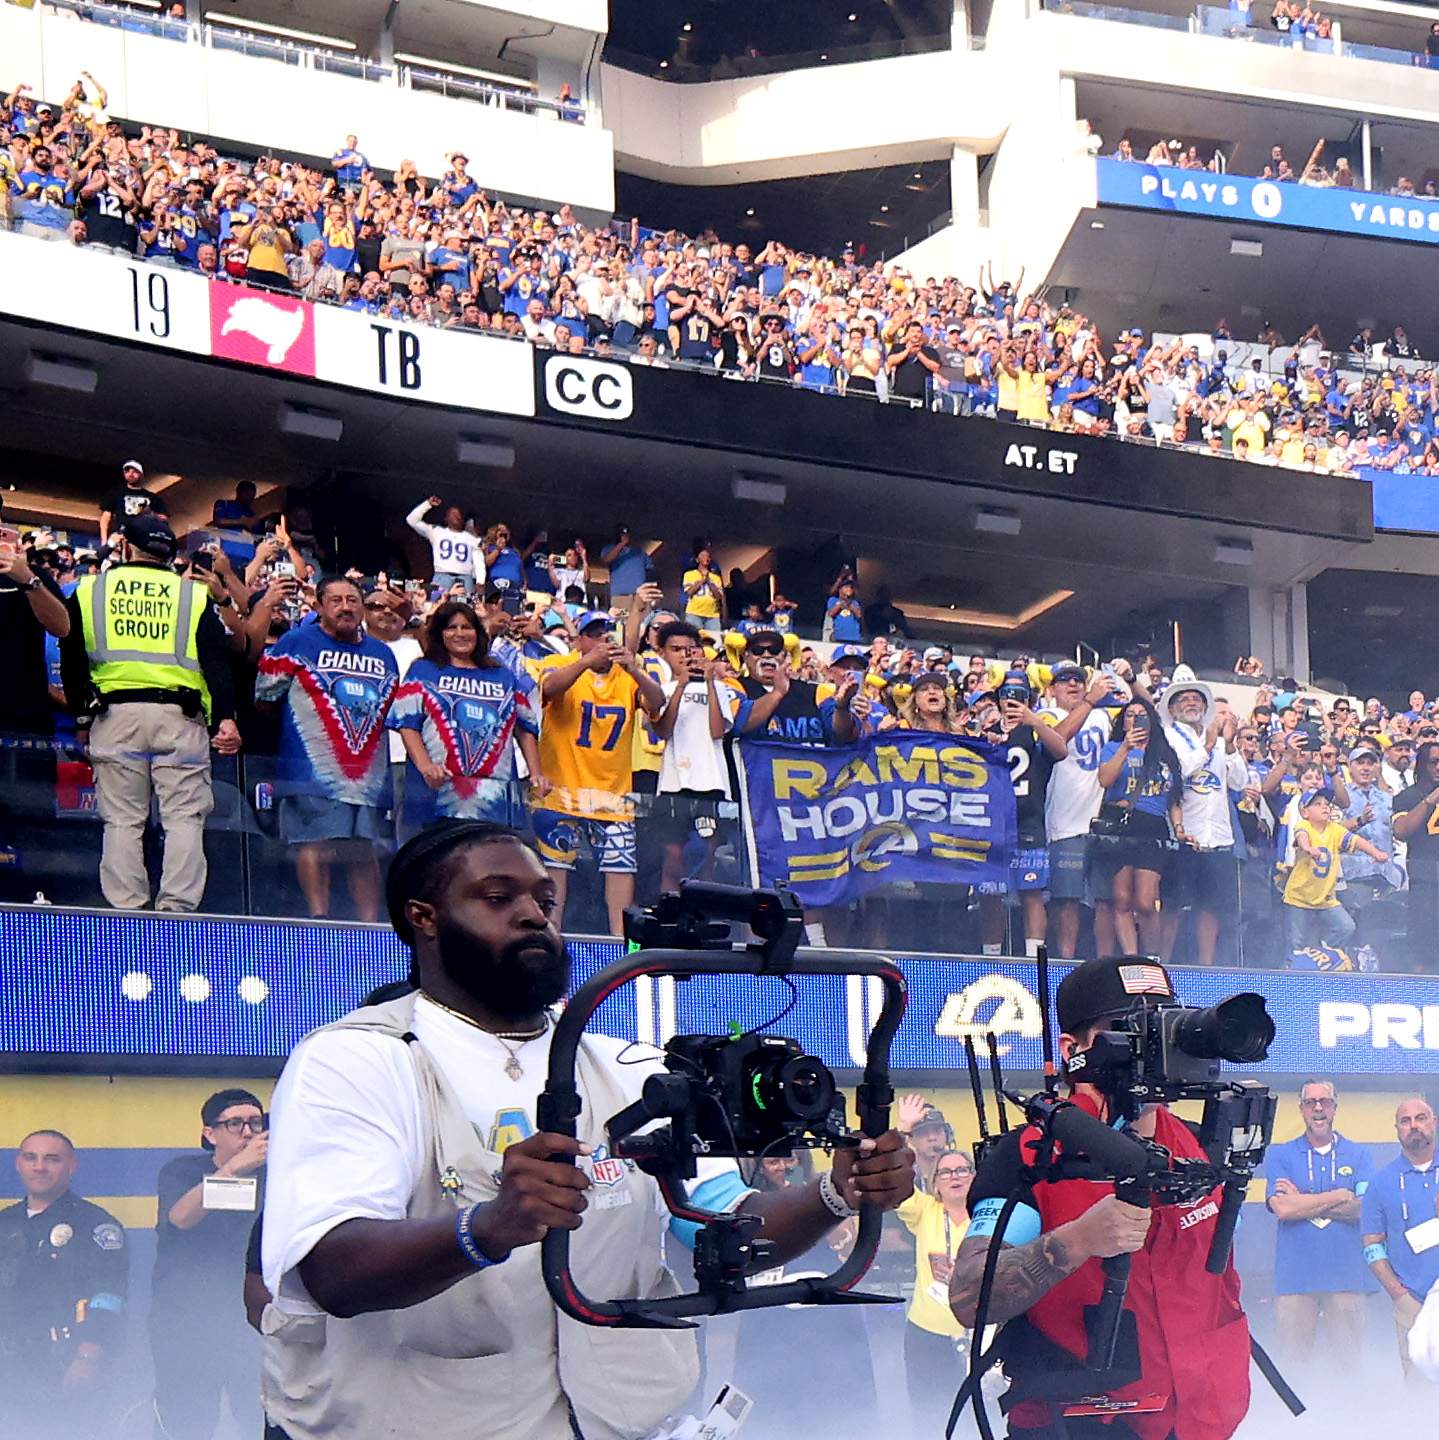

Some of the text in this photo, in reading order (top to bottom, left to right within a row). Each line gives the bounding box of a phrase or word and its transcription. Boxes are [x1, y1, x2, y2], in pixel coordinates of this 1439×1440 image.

[97, 193, 122, 219] 12
[1140, 174, 1282, 218] PLAYS 0
[128, 267, 170, 338] 19
[370, 324, 423, 391] TB
[769, 346, 782, 367] 9
[555, 368, 624, 412] CC
[1353, 410, 1370, 428] 12
[1005, 443, 1078, 475] AT. ET
[440, 539, 468, 563] 99
[113, 579, 171, 598] APEX
[110, 596, 173, 619] SECURITY
[114, 619, 170, 640] GROUP
[317, 650, 386, 676] GIANTS
[439, 675, 505, 699] GIANTS
[576, 700, 626, 751] 17
[772, 744, 990, 800] RAMS
[1008, 746, 1030, 796] 2
[779, 788, 991, 842] HOUSE
[1313, 846, 1331, 878] 9
[592, 1160, 624, 1182] NFL
[596, 1190, 632, 1210] MEDIA
